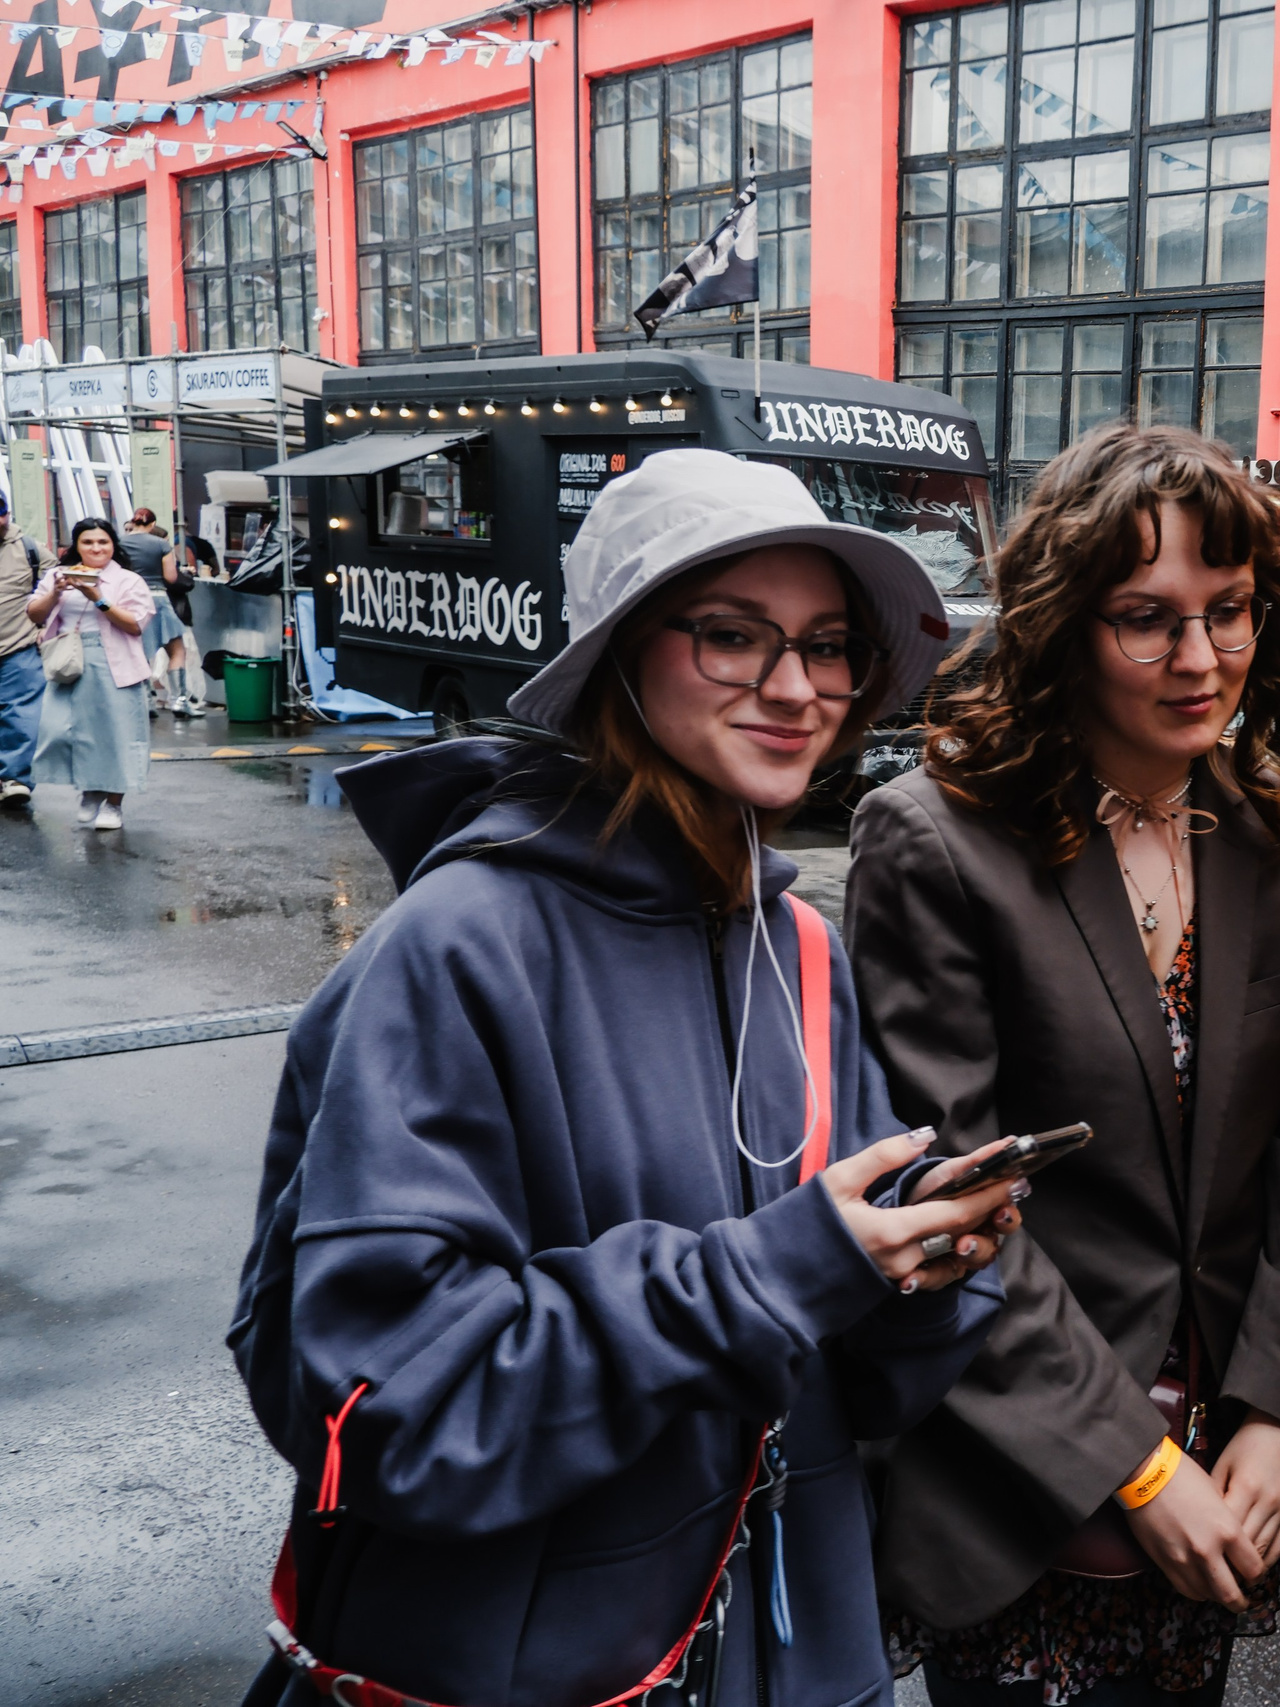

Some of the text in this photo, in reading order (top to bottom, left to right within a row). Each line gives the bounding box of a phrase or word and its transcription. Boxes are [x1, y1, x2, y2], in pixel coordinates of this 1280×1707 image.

[69, 379, 102, 396] SKREPKA
[186, 368, 269, 391] SKURATOV COFFEE
[760, 401, 970, 461] UNDERDOG
[610, 454, 626, 472] 600
[337, 564, 543, 651] UNDERDOG
